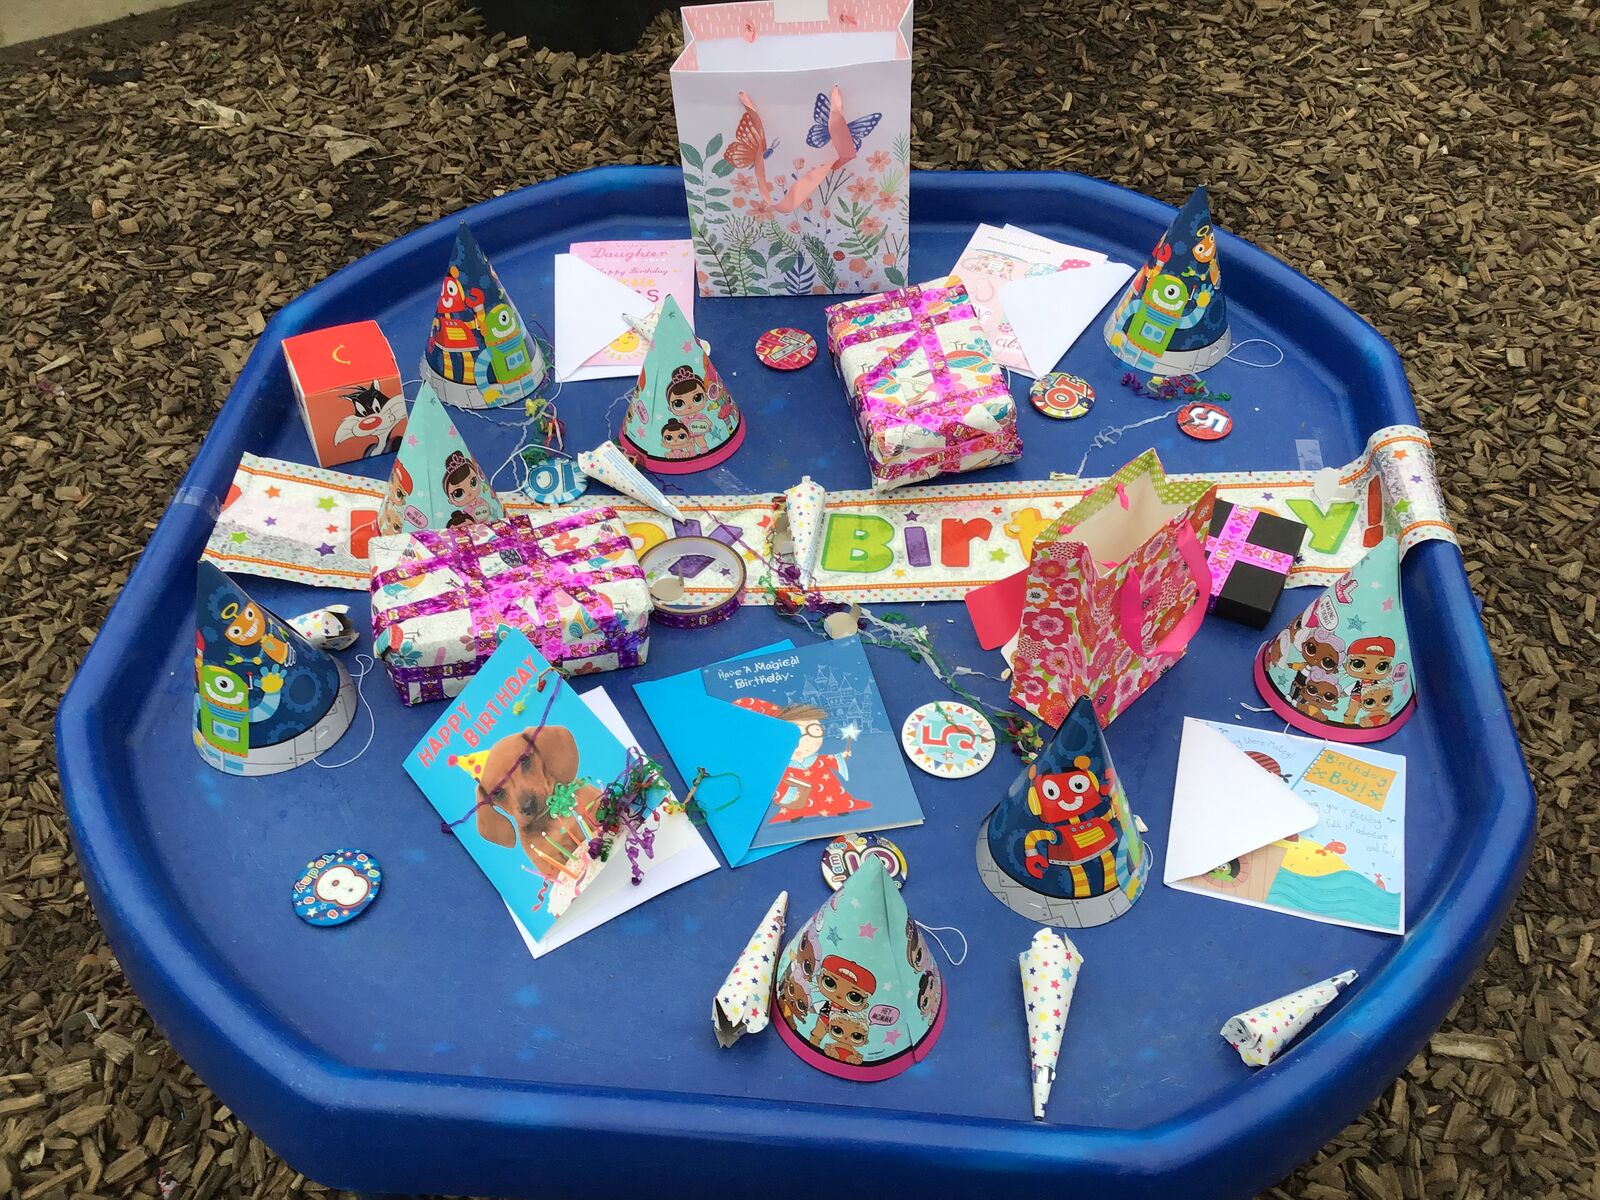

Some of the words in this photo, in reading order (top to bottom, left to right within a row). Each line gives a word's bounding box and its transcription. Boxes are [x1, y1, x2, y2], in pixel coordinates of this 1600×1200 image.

[591, 248, 668, 262] Daughter
[628, 267, 668, 277] Birthday
[1189, 406, 1229, 433] 5
[718, 670, 742, 680] Have
[743, 665, 752, 674] A
[754, 656, 800, 673] Magical
[735, 672, 790, 689] Birthday
[462, 655, 537, 748] BIRTHDAY
[417, 702, 471, 768] HAPPY
[922, 723, 977, 751] 5
[1325, 754, 1388, 788] Birthday
[1329, 770, 1366, 797] Boy!
[294, 854, 336, 893] Today
[829, 854, 845, 874] am
[315, 864, 371, 908] 8
